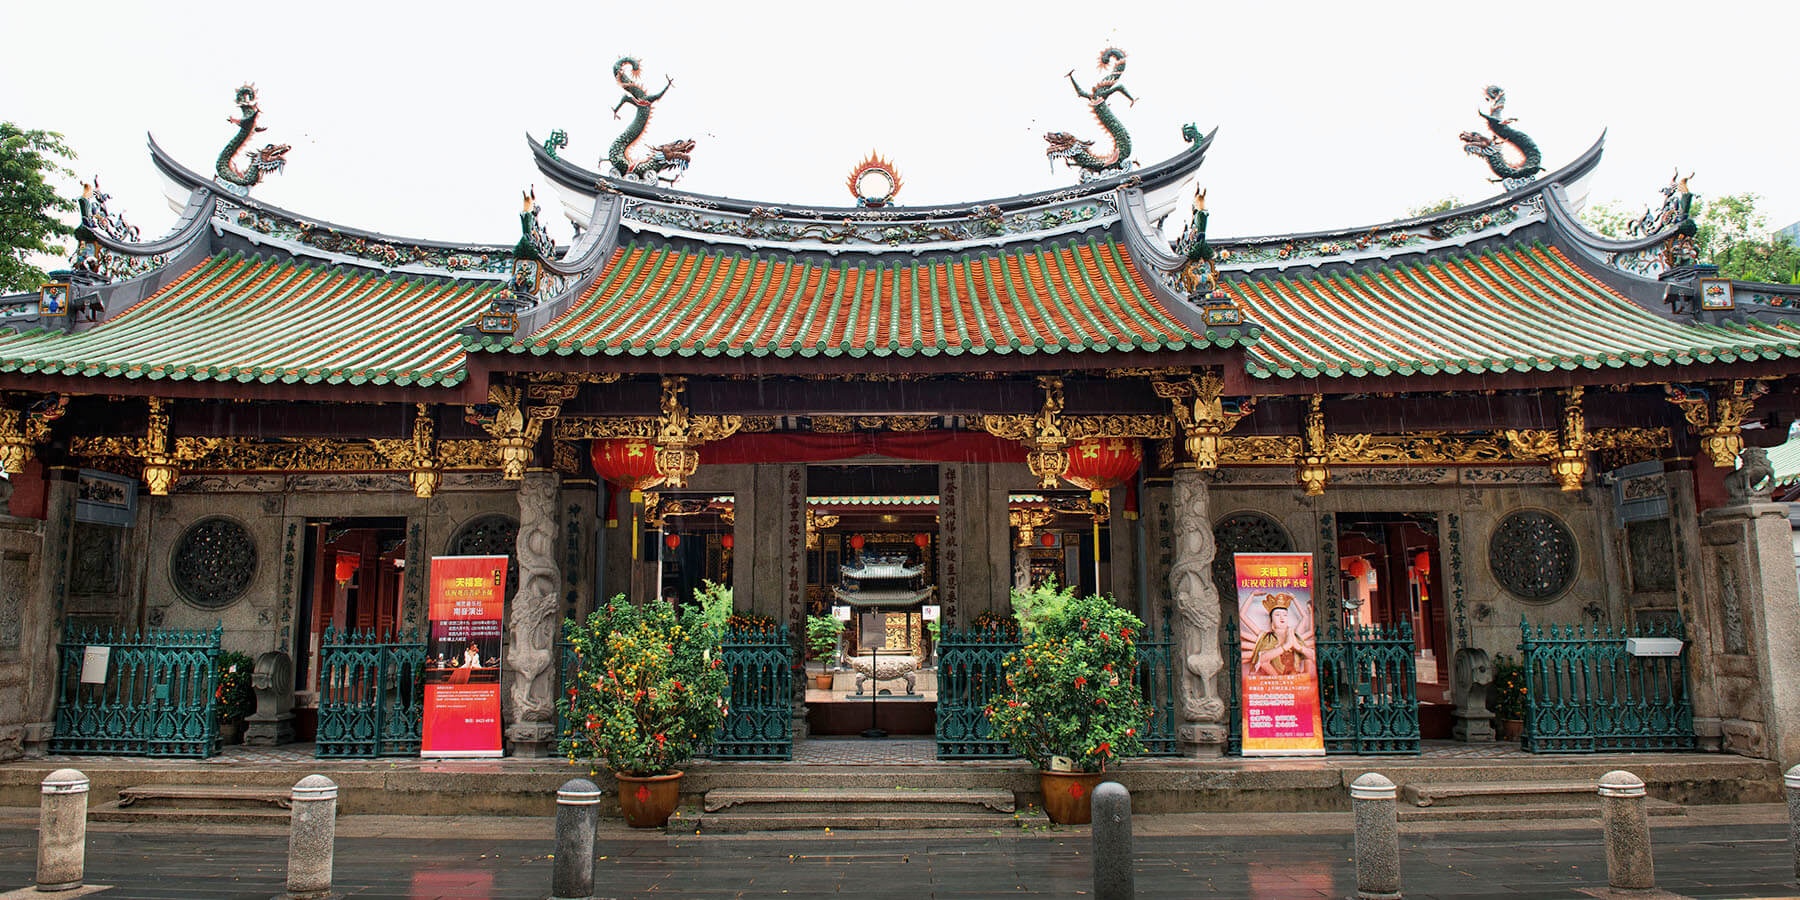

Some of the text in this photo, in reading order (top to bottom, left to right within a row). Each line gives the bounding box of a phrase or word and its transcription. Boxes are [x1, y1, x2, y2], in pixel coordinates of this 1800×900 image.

[1260, 567, 1288, 577] 天福宫
[455, 577, 483, 587] 天福宫
[1241, 579, 1308, 588] 庆祝观音菩萨圣诞
